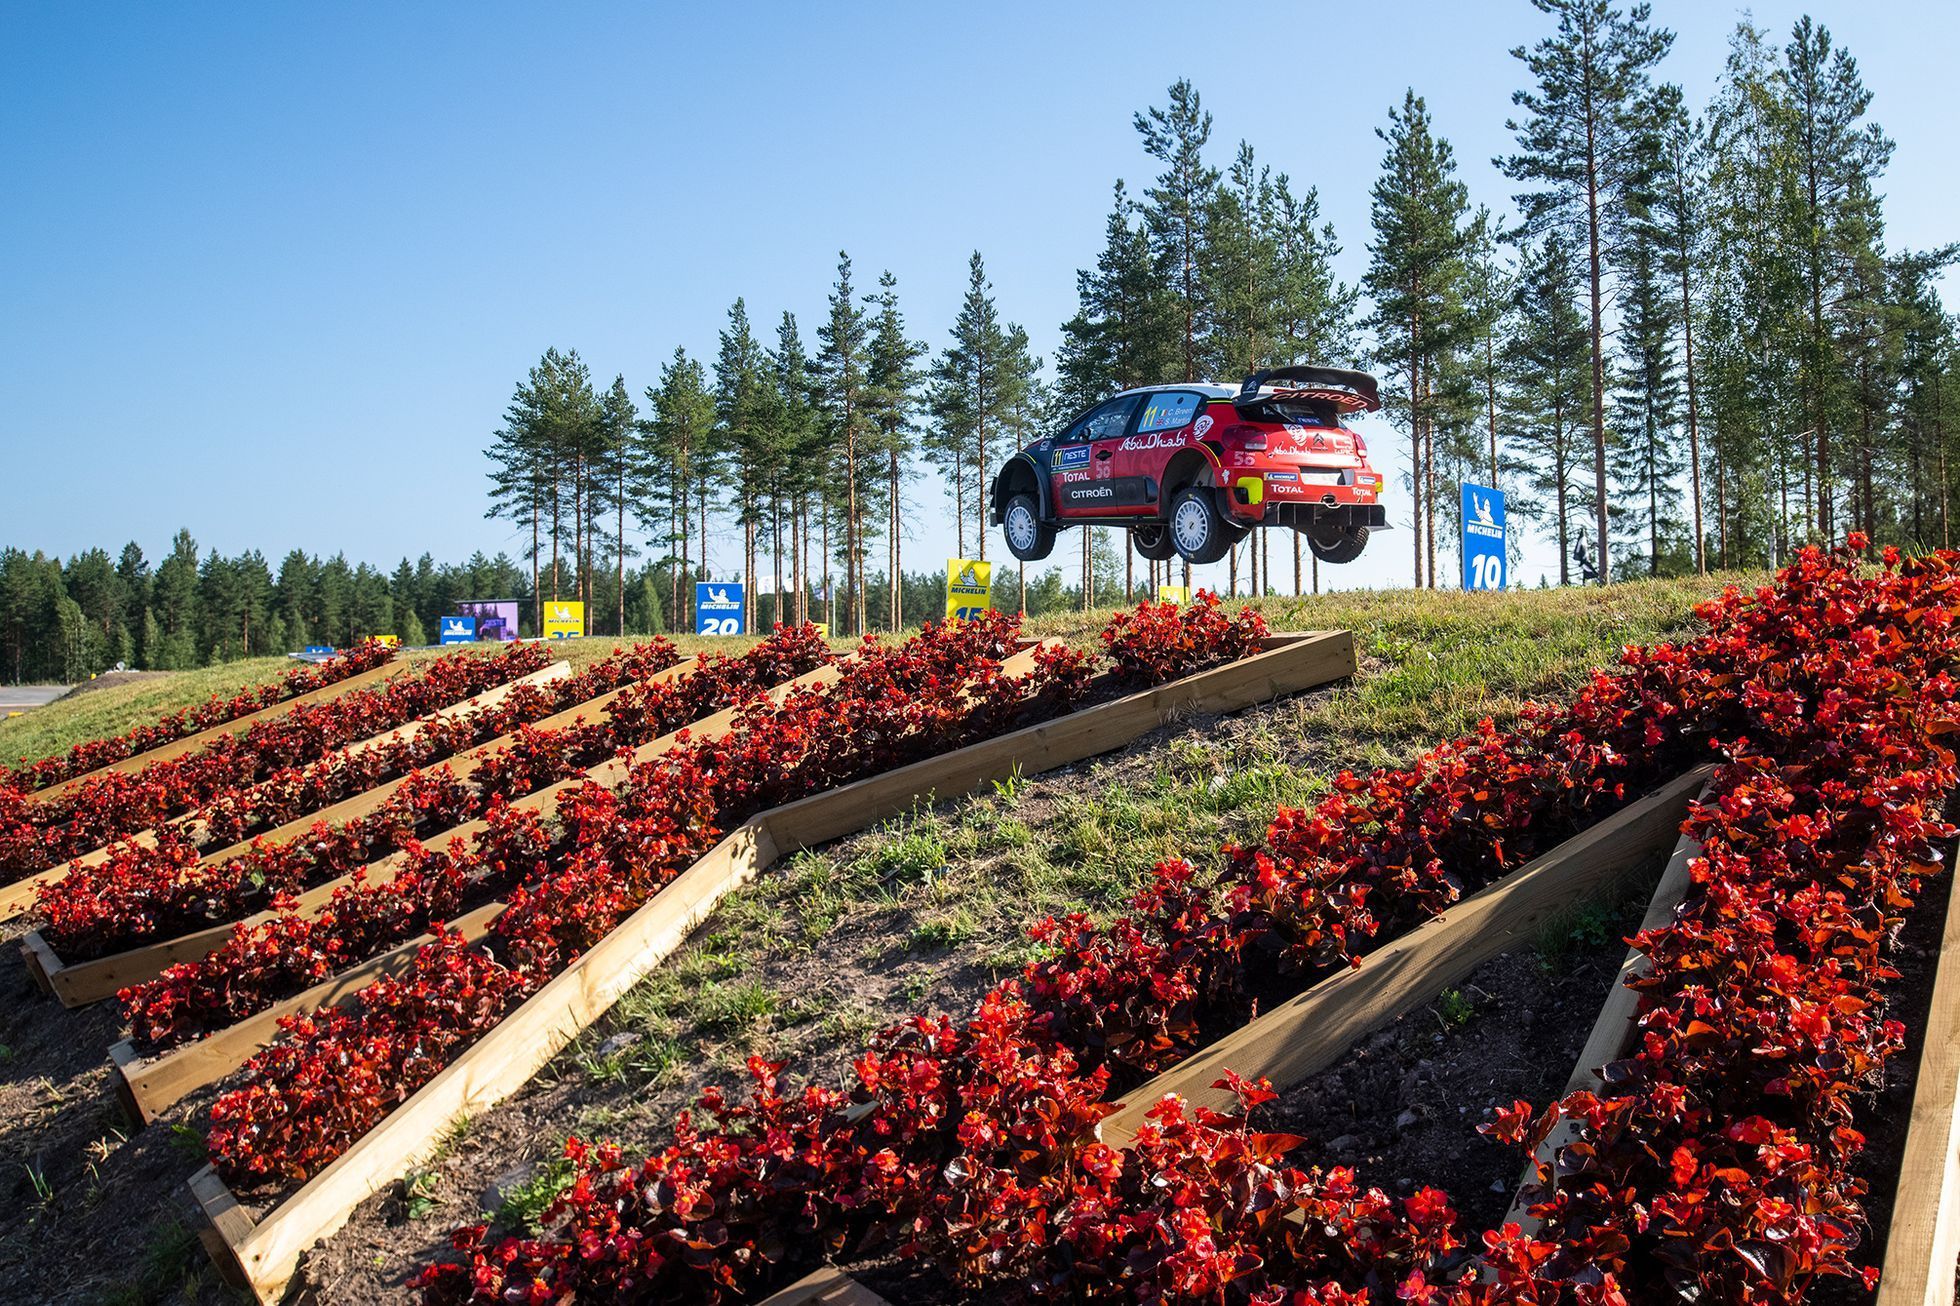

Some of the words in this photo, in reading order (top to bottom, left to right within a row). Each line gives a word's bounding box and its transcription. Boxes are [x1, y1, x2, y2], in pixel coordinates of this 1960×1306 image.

[1272, 392, 1367, 408] CITROËN
[1143, 406, 1158, 427] 11
[1054, 450, 1062, 465] 11
[1063, 472, 1090, 483] TOTAL
[1071, 487, 1113, 499] CITROËN
[1271, 484, 1304, 494] TOTAL
[1352, 486, 1372, 496] TOTAL
[1467, 524, 1503, 539] MICHELIN
[1471, 553, 1502, 590] 10
[700, 618, 739, 636] 20
